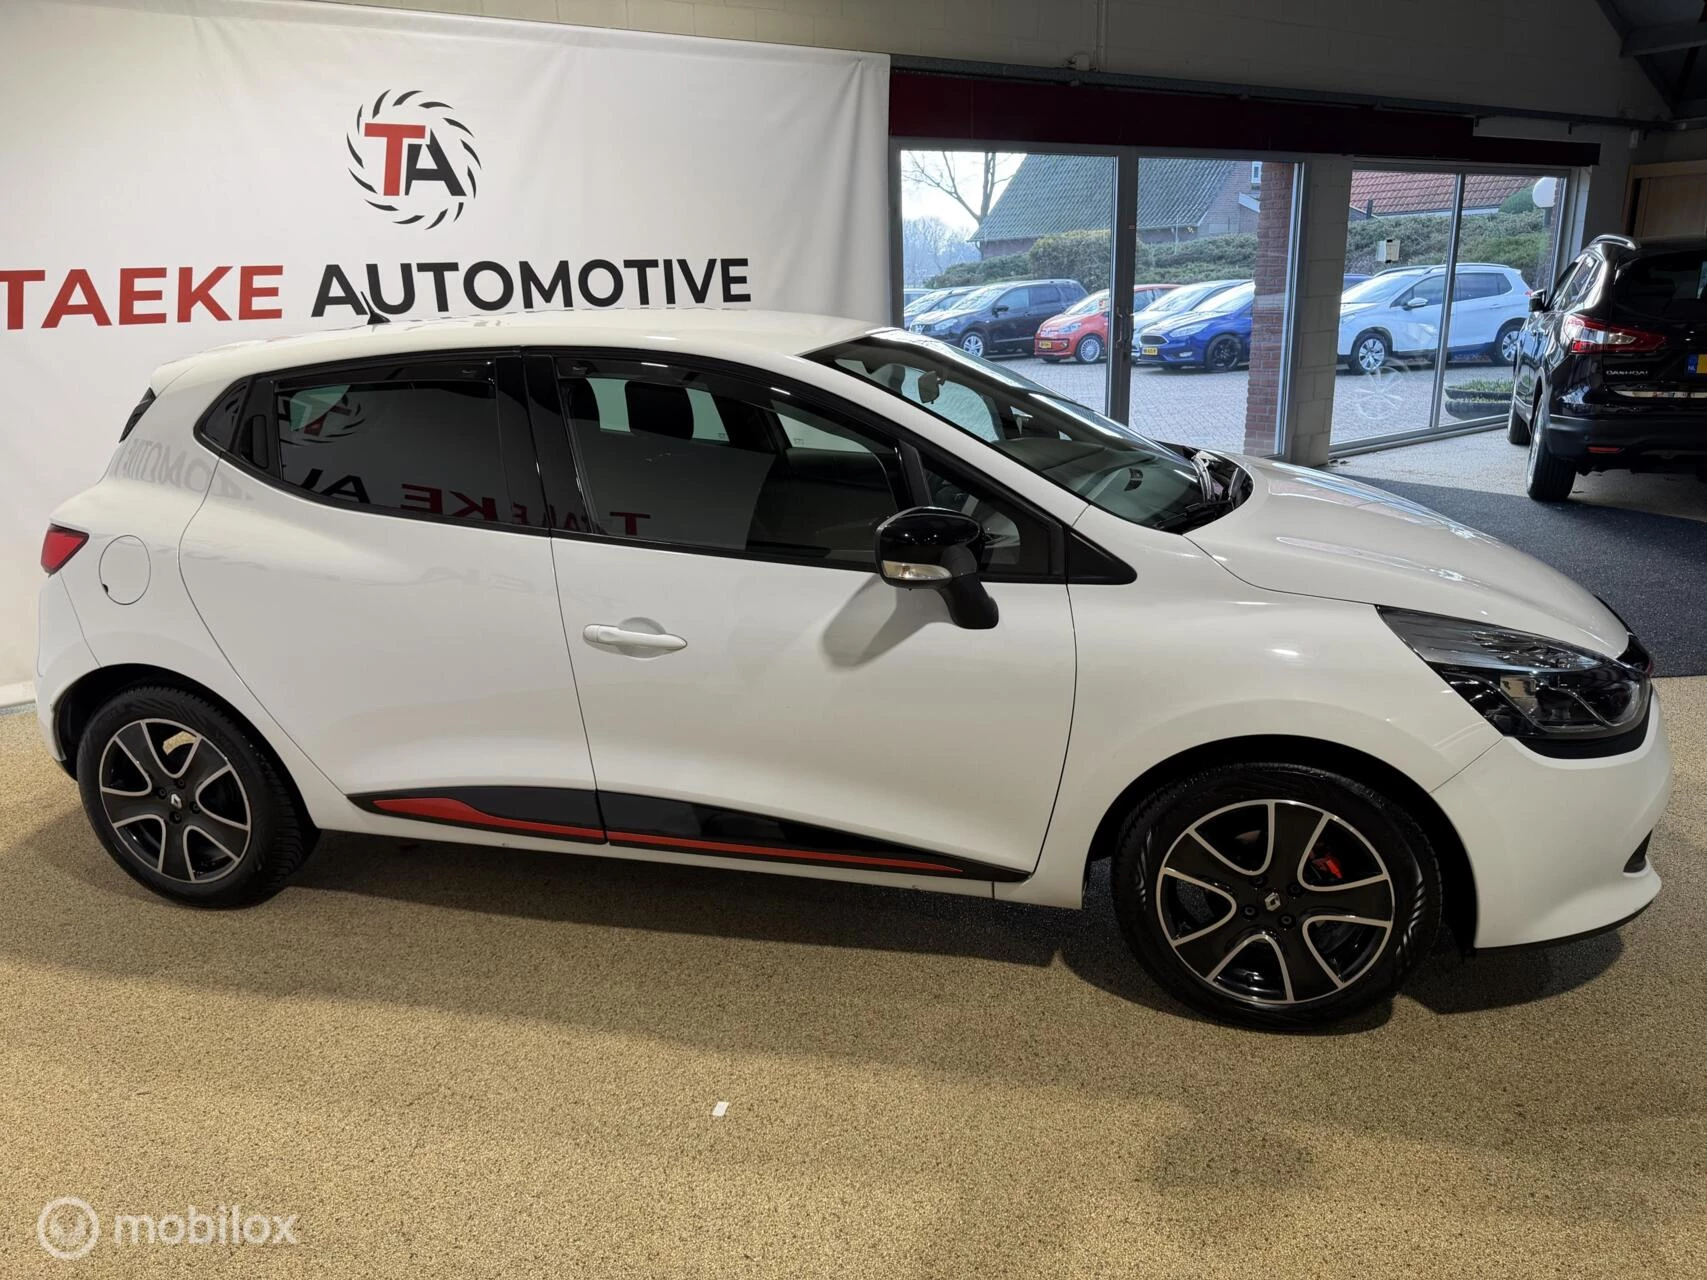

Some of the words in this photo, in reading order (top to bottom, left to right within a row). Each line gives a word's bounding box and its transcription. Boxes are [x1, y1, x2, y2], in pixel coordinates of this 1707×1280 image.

[364, 122, 467, 196] TA
[0, 265, 284, 330] TAEKE
[311, 258, 751, 318] AUTOMOTIVE
